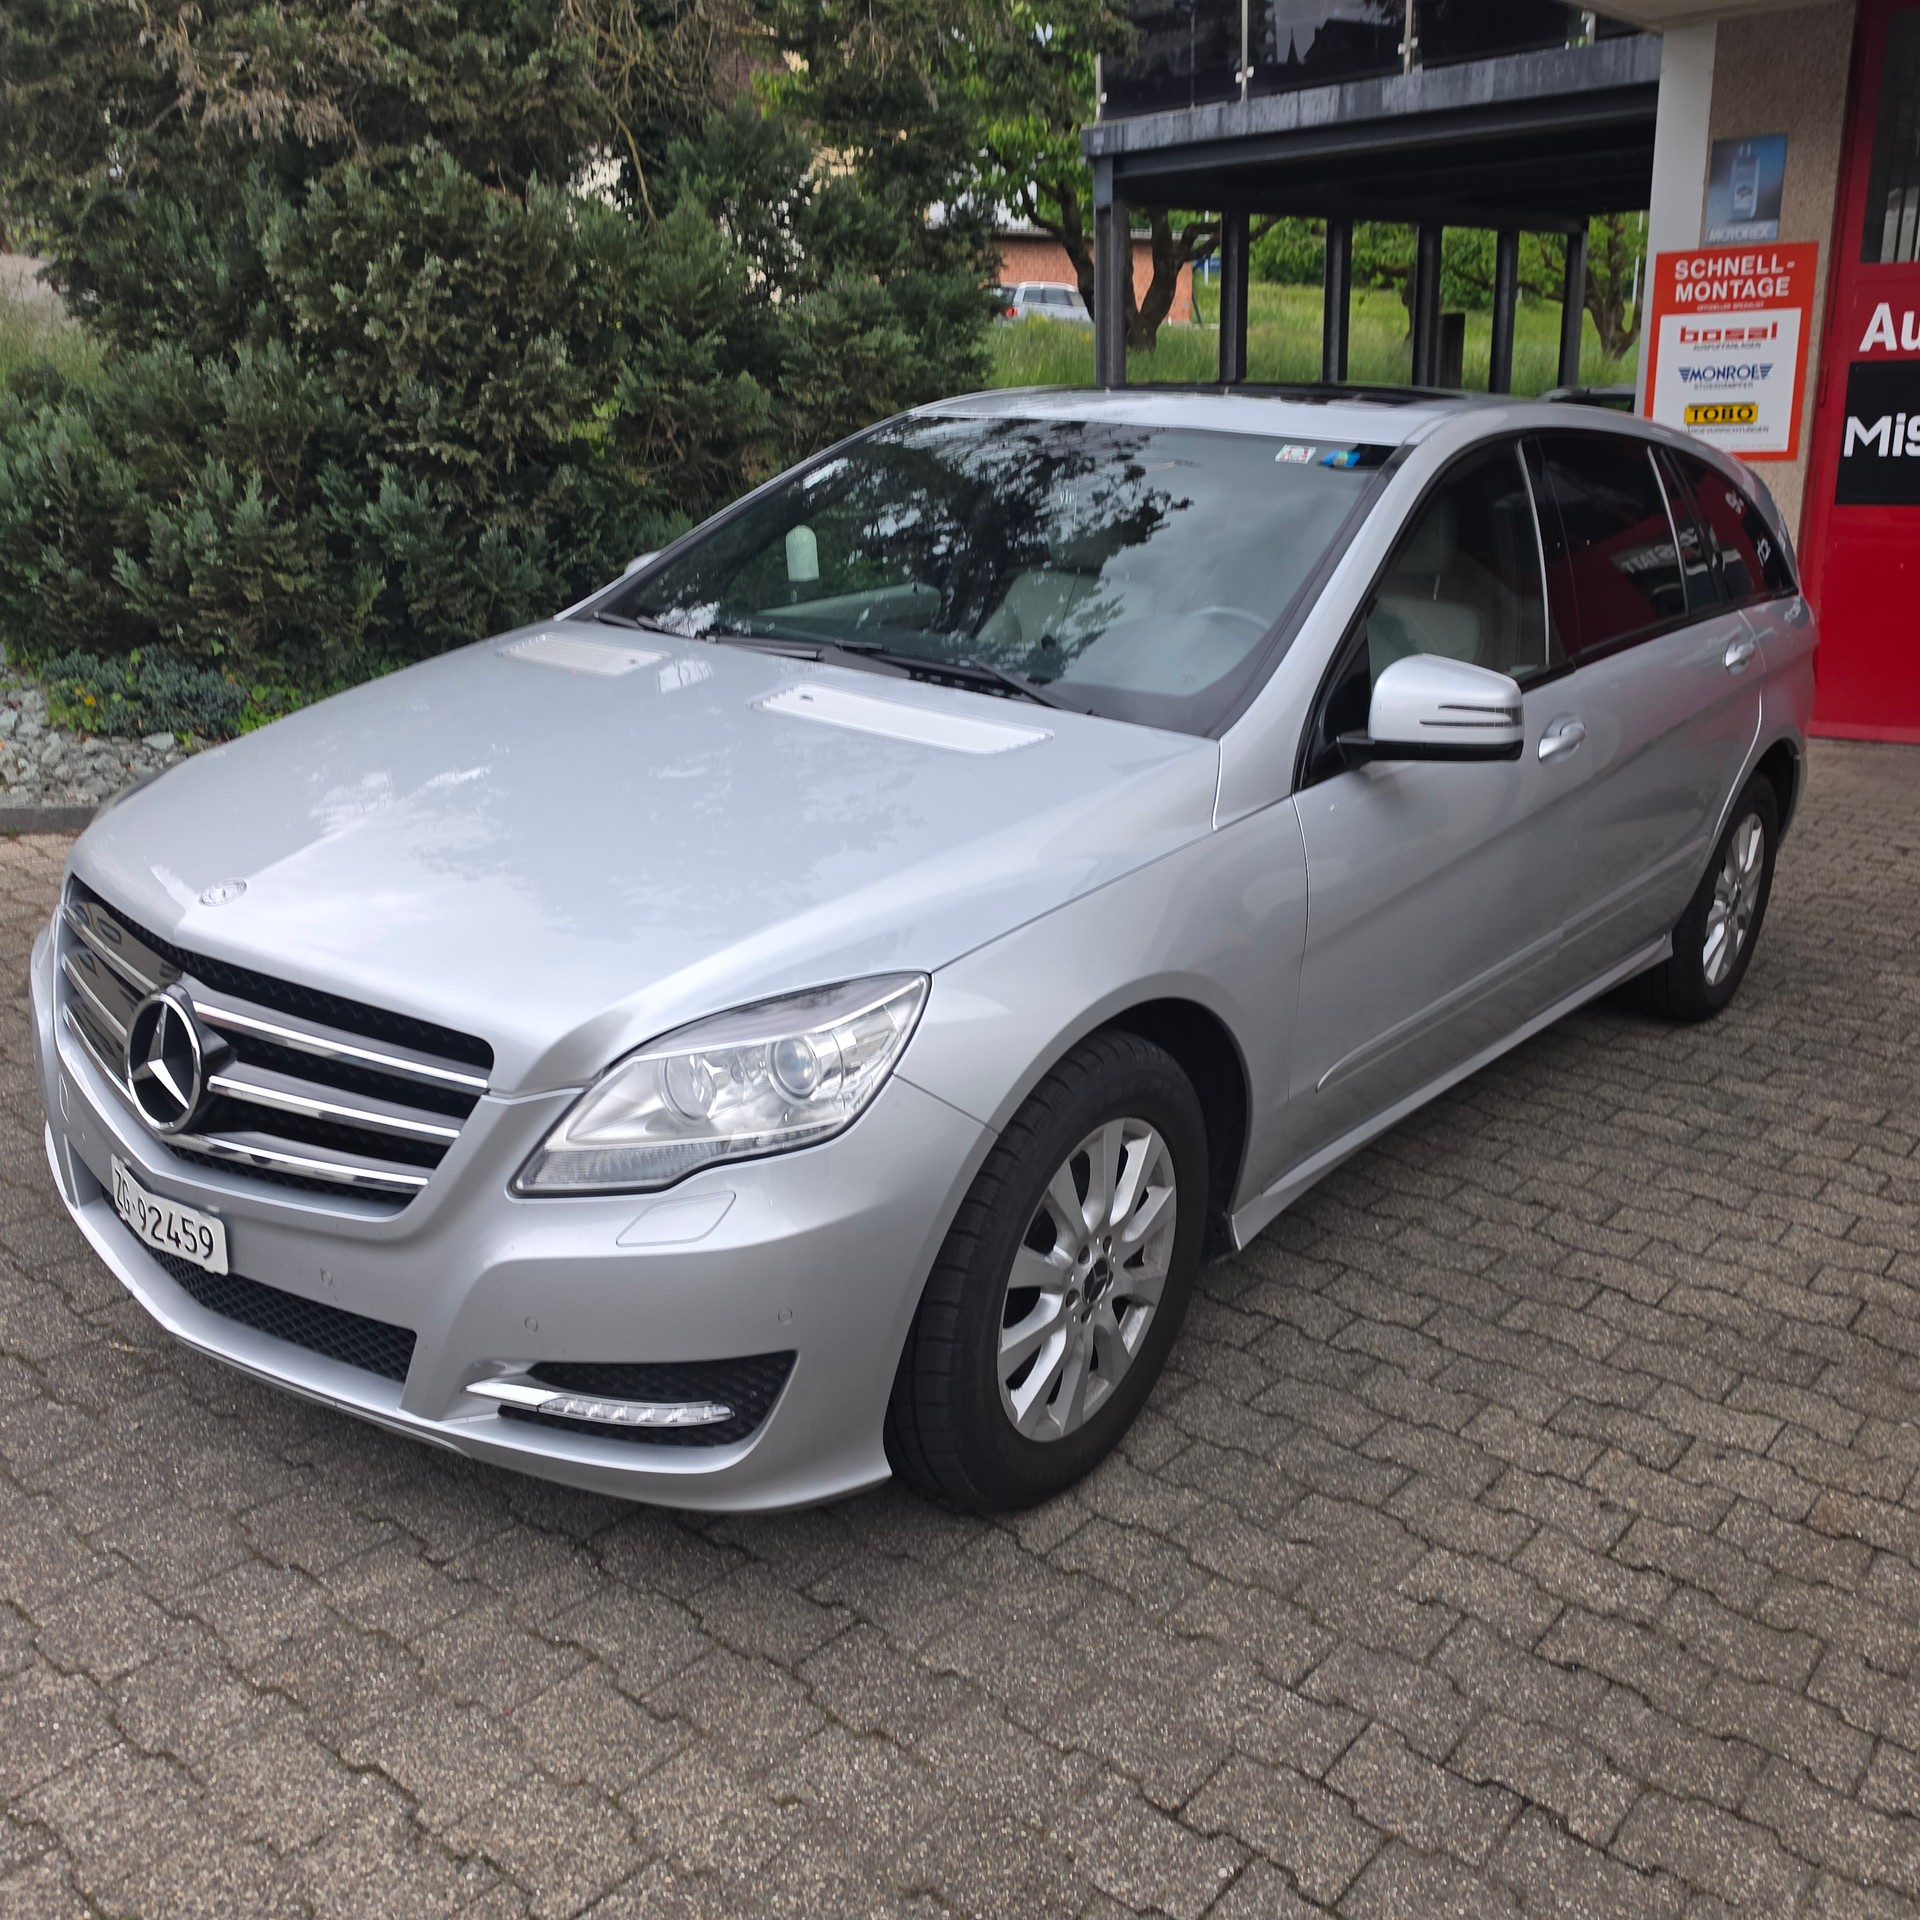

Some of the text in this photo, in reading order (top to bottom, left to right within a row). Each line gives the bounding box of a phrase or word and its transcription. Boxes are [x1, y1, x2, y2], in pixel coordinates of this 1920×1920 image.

[1675, 253, 1795, 281] SCHNELL-
[1675, 276, 1790, 303] MONTAGE
[1680, 320, 1778, 344] bosal
[1689, 364, 1760, 382] MONROE
